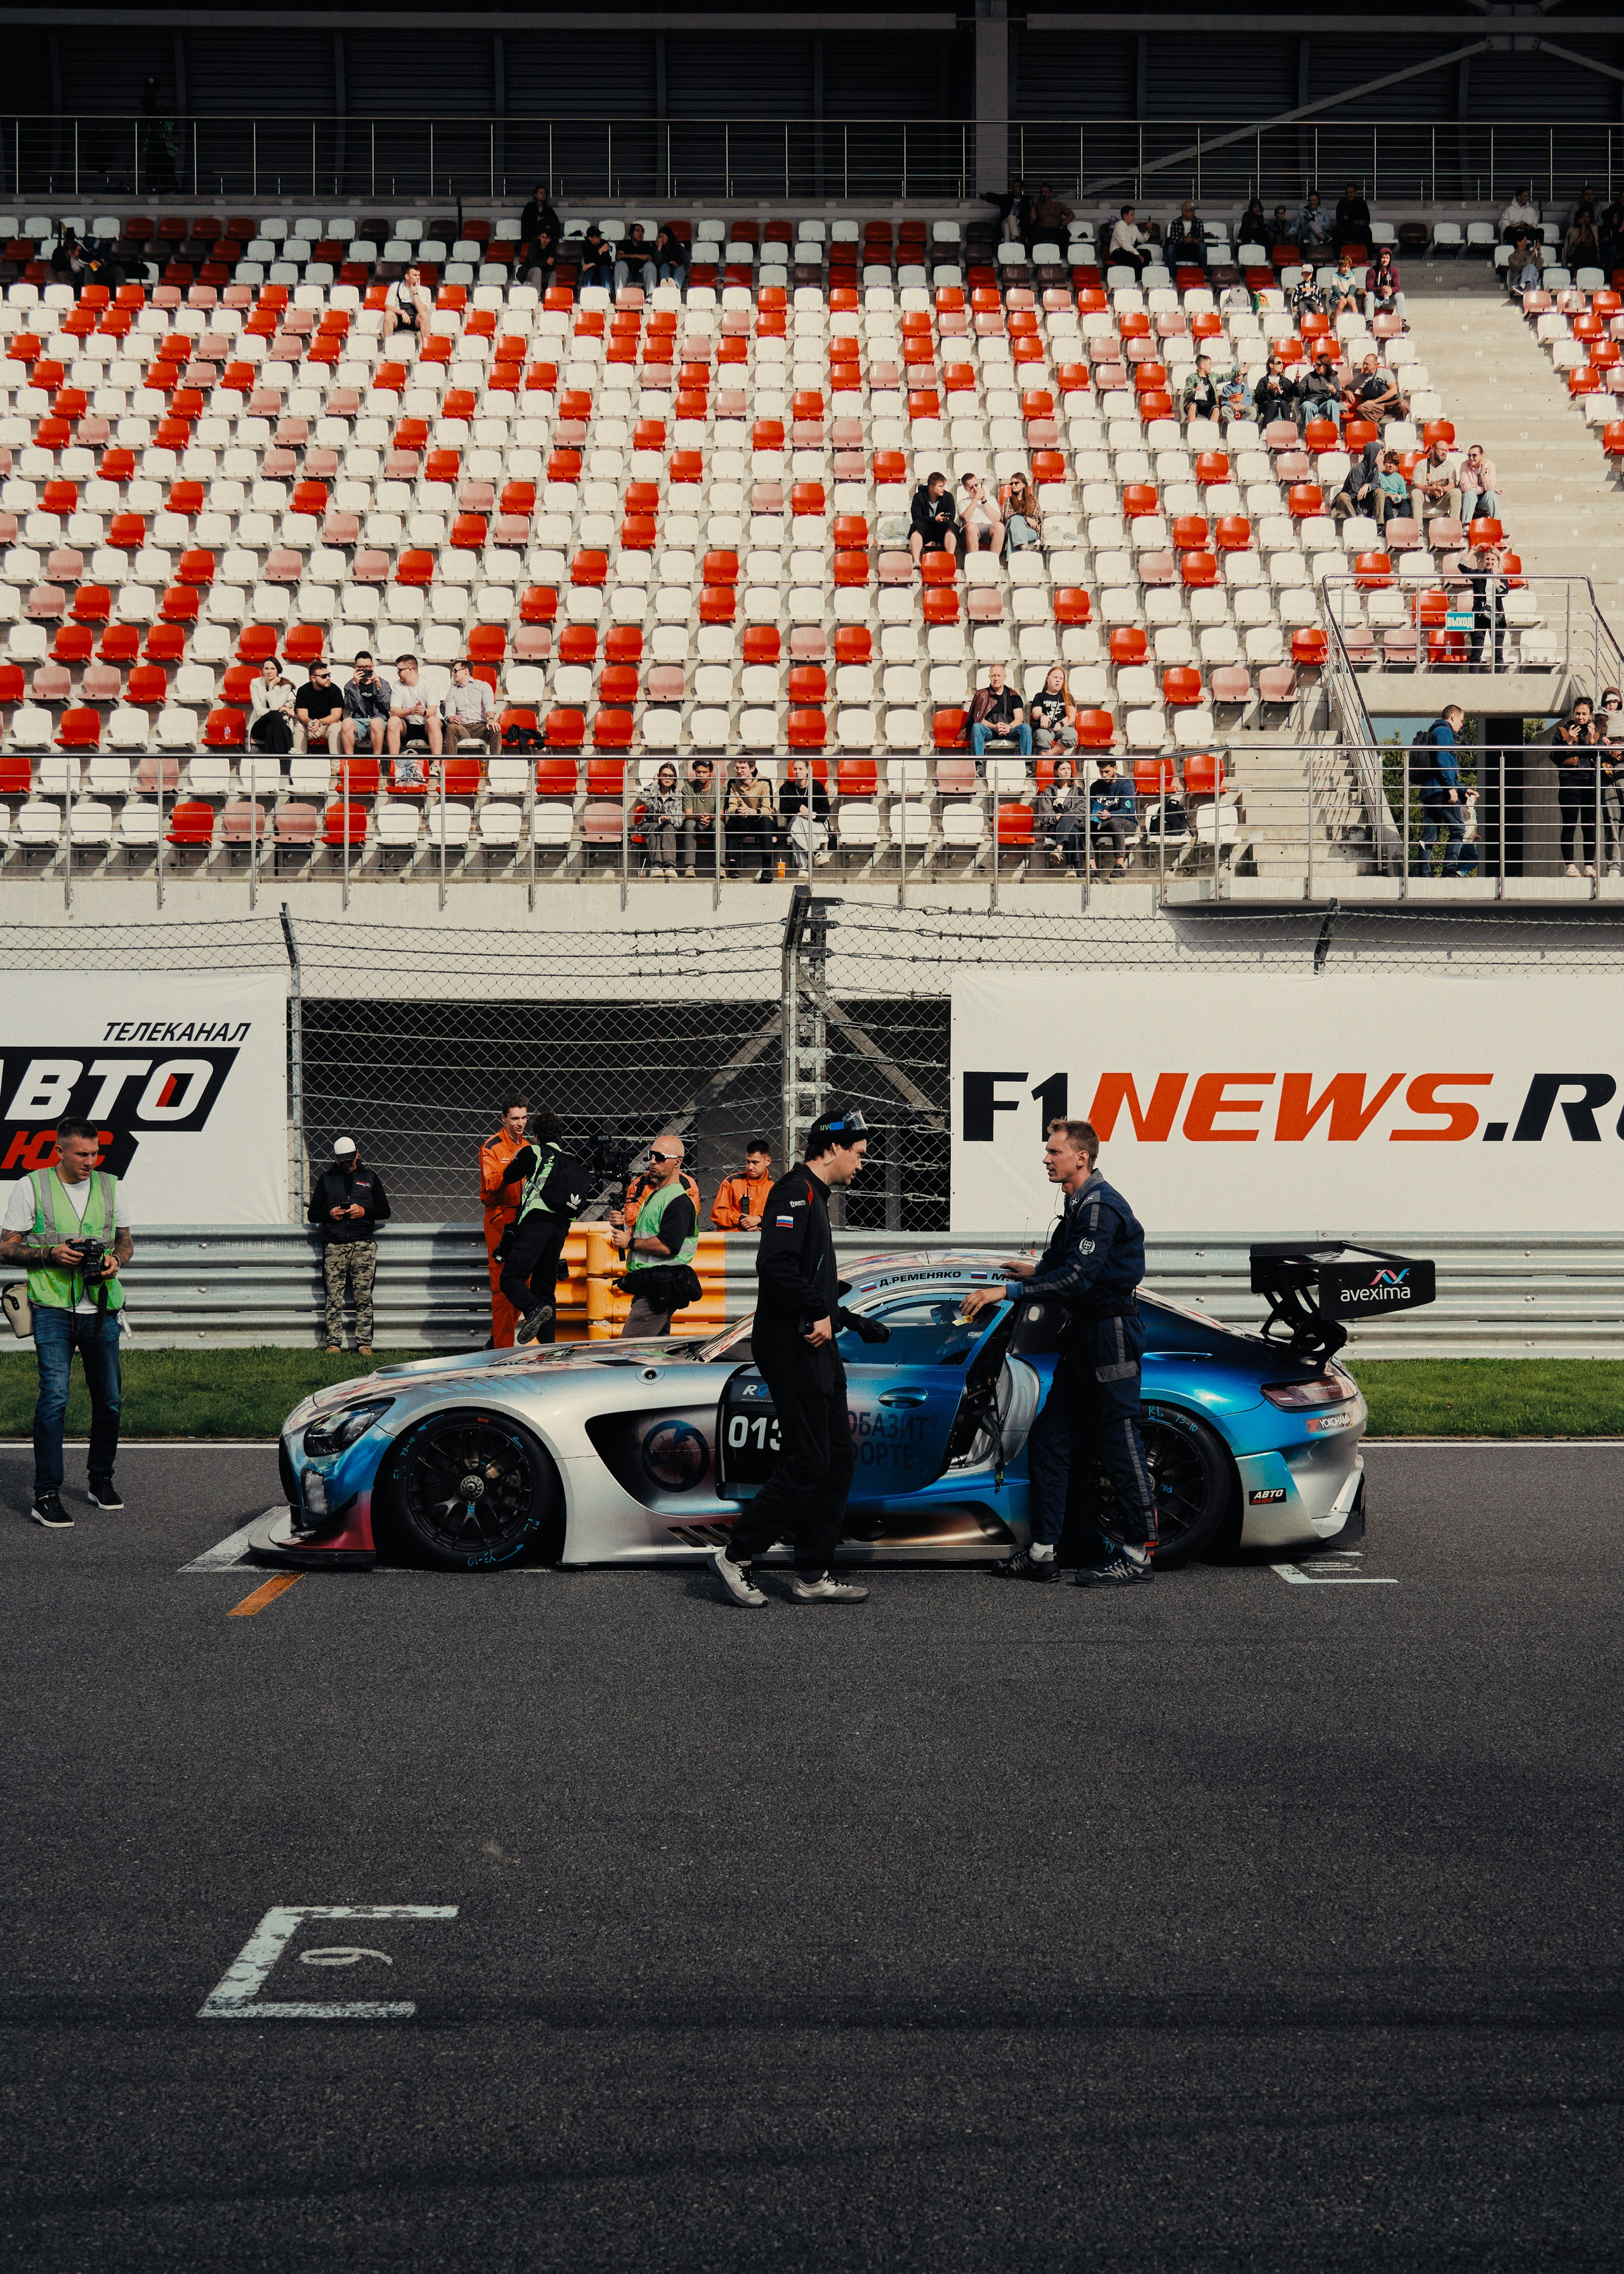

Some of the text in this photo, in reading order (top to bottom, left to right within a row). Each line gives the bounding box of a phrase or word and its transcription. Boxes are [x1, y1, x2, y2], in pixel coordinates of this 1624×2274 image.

[1447, 617, 1473, 629] ВЫХОД
[103, 1022, 252, 1042] ТЕЛЕКАНАЛ
[0, 1059, 214, 1121] ВТО
[963, 1071, 1624, 1142] F1NEWS.R
[566, 1201, 578, 1211] adidas
[879, 1271, 961, 1287] Д.РЕМЕНЯКО
[1340, 1284, 1411, 1302] avexima
[1148, 1405, 1164, 1417] RL
[1319, 1415, 1351, 1428] YOKOHAMA
[1253, 1489, 1284, 1499] АВТО
